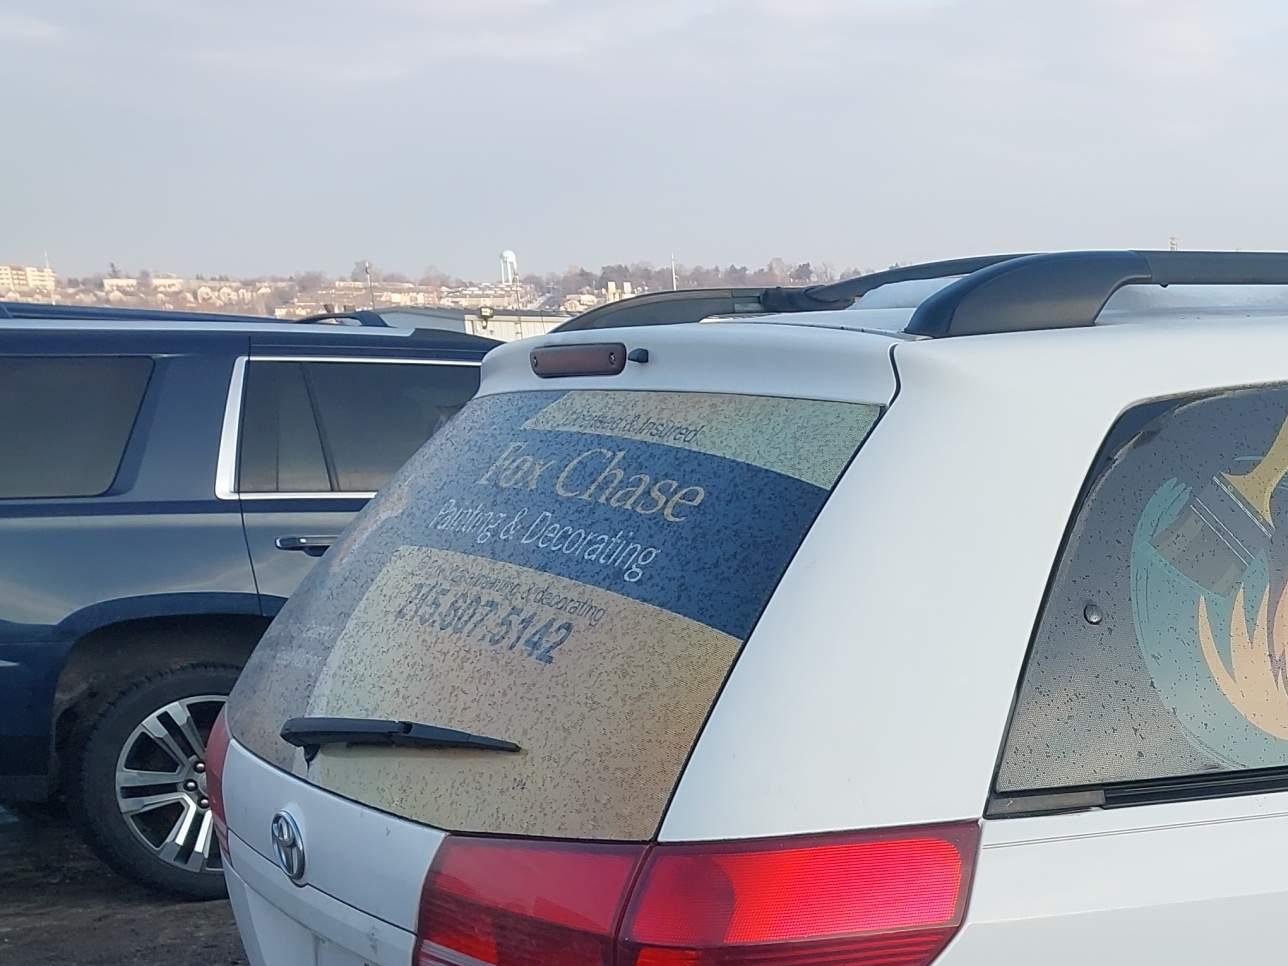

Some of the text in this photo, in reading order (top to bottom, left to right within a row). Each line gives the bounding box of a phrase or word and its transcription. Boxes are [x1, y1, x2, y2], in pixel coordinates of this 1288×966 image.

[476, 441, 705, 522] Fox Chase
[500, 506, 528, 540] &
[520, 511, 661, 583] Decorating
[534, 586, 607, 627] decorating
